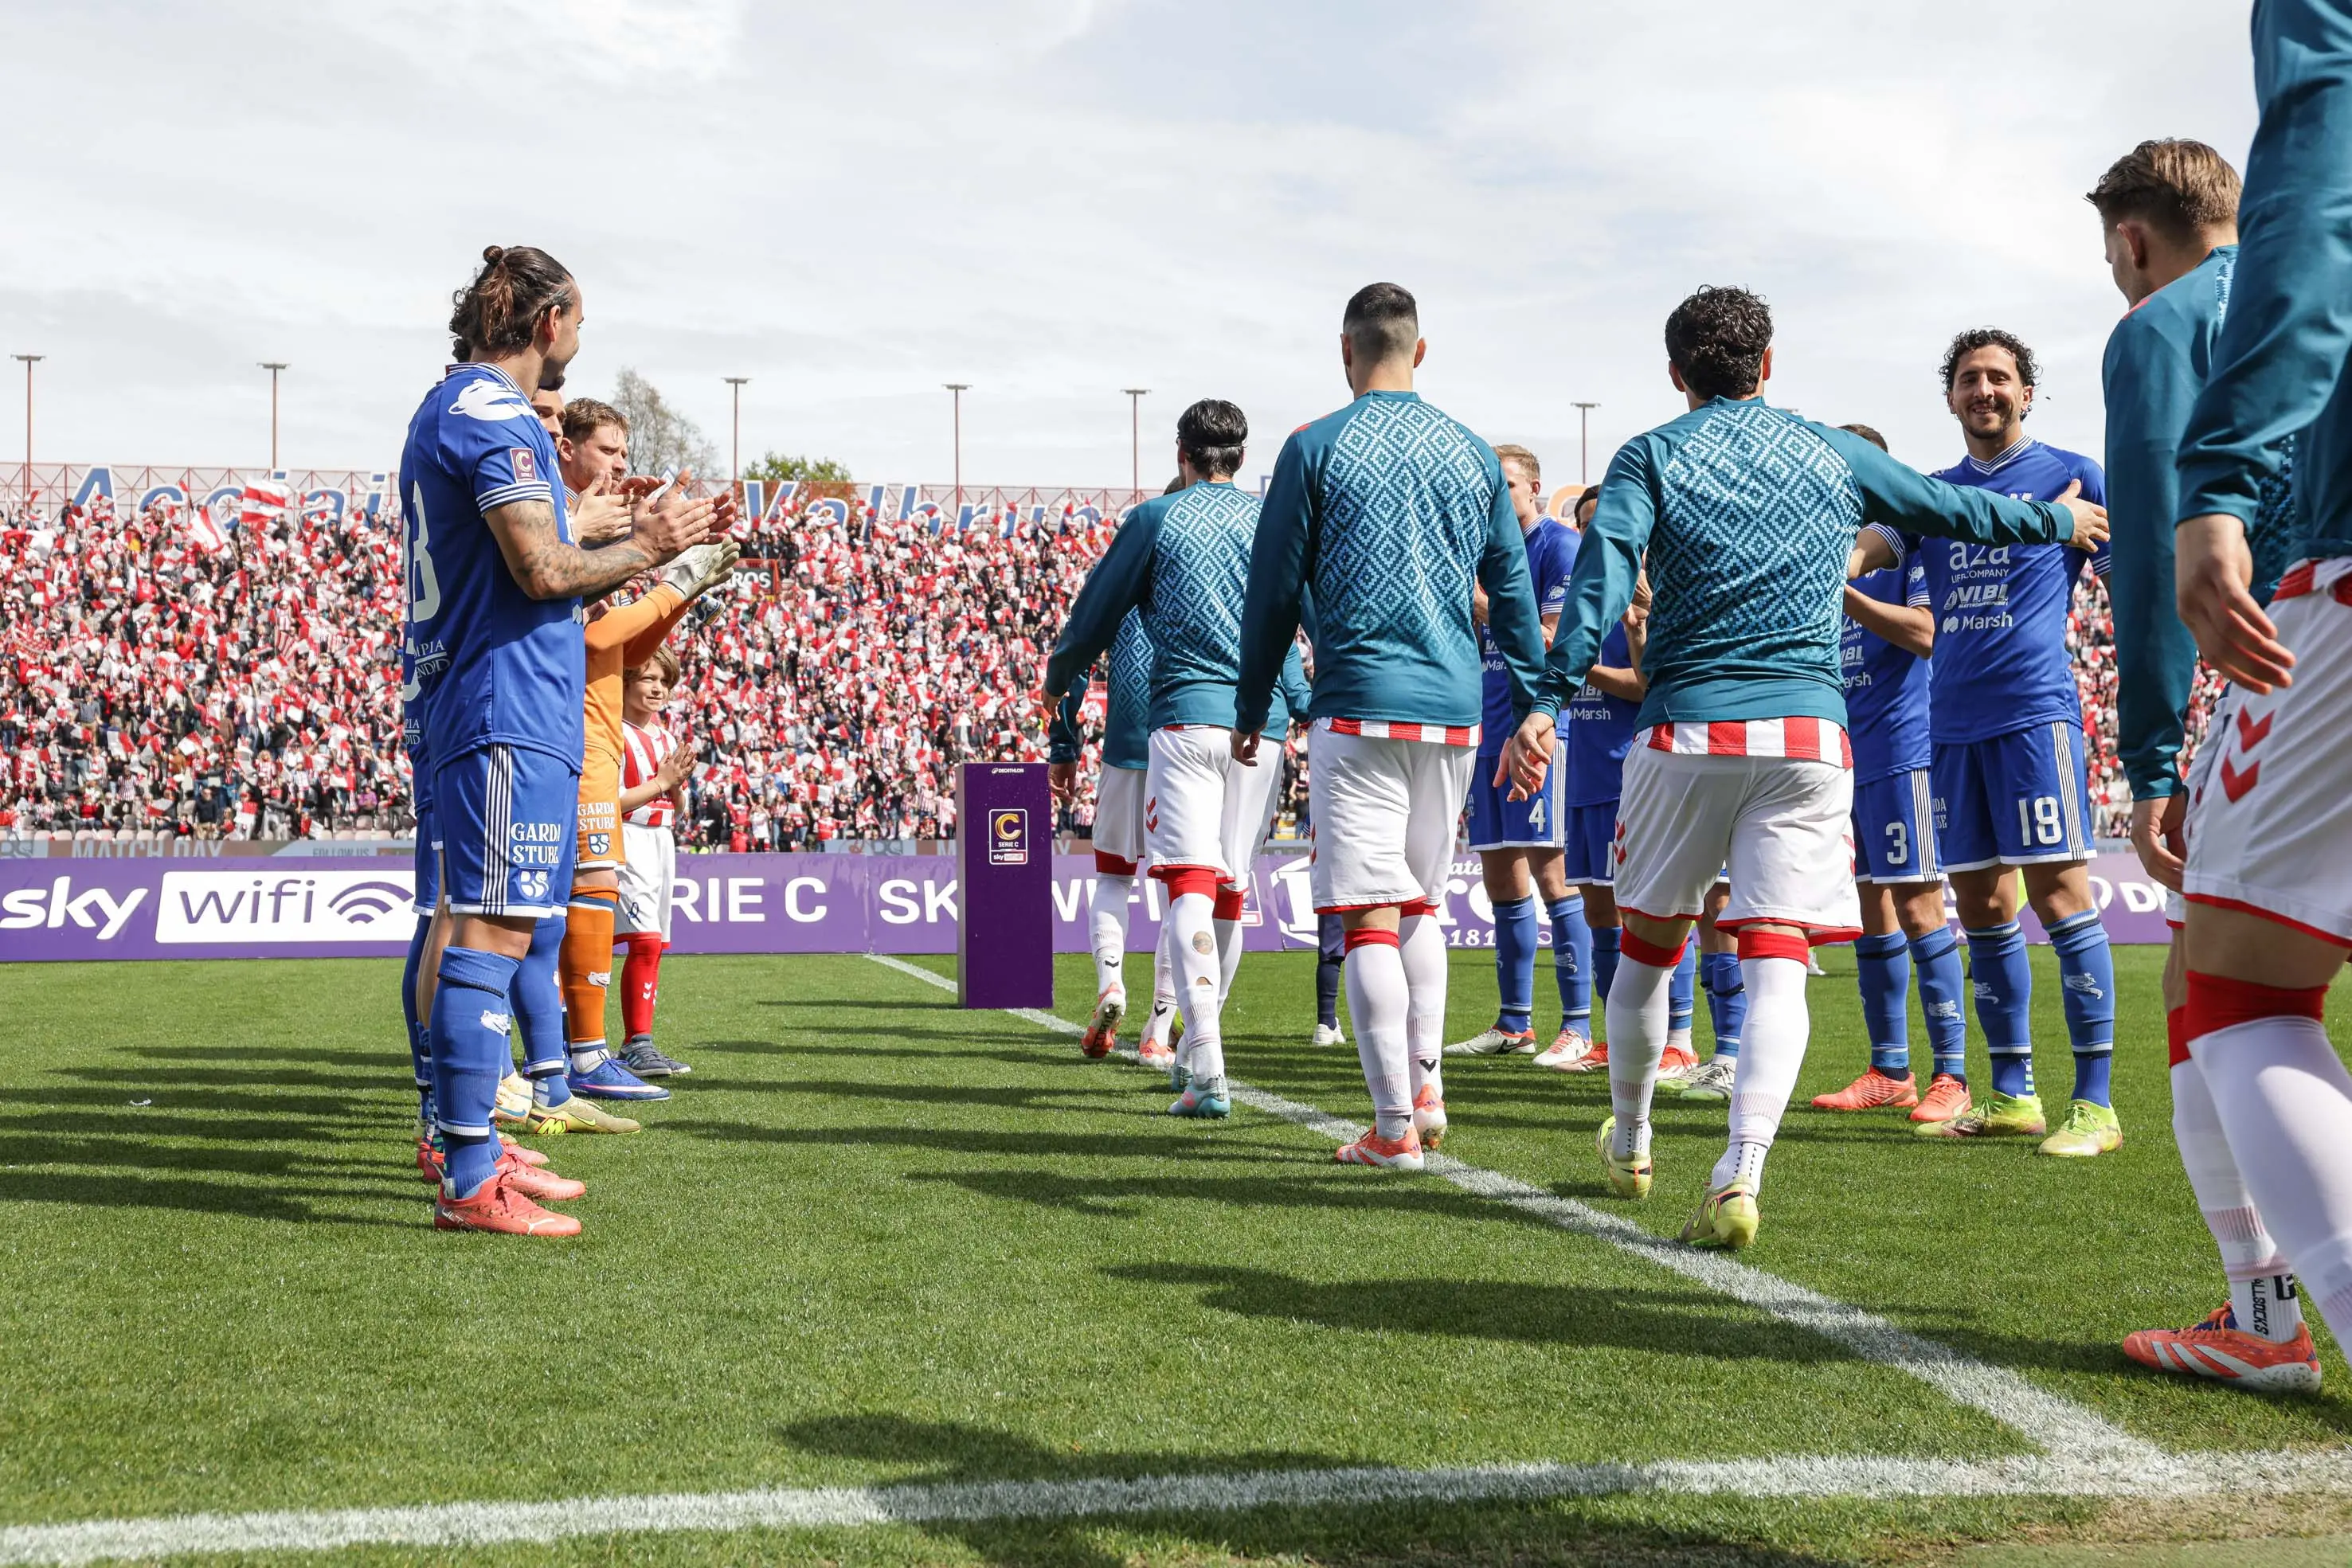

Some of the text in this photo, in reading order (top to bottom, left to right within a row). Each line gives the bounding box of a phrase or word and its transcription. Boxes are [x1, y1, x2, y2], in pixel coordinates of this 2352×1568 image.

[743, 480, 1134, 542] Valbrun
[1961, 612, 2013, 631] Marsh
[1487, 659, 1506, 671] Mar
[1573, 707, 1610, 720] Marsh
[1529, 798, 1545, 832] 4
[2018, 797, 2062, 846] 18
[1886, 822, 1908, 864] 3
[0, 876, 149, 940] sky
[179, 880, 316, 924] wifi
[785, 877, 827, 922] C
